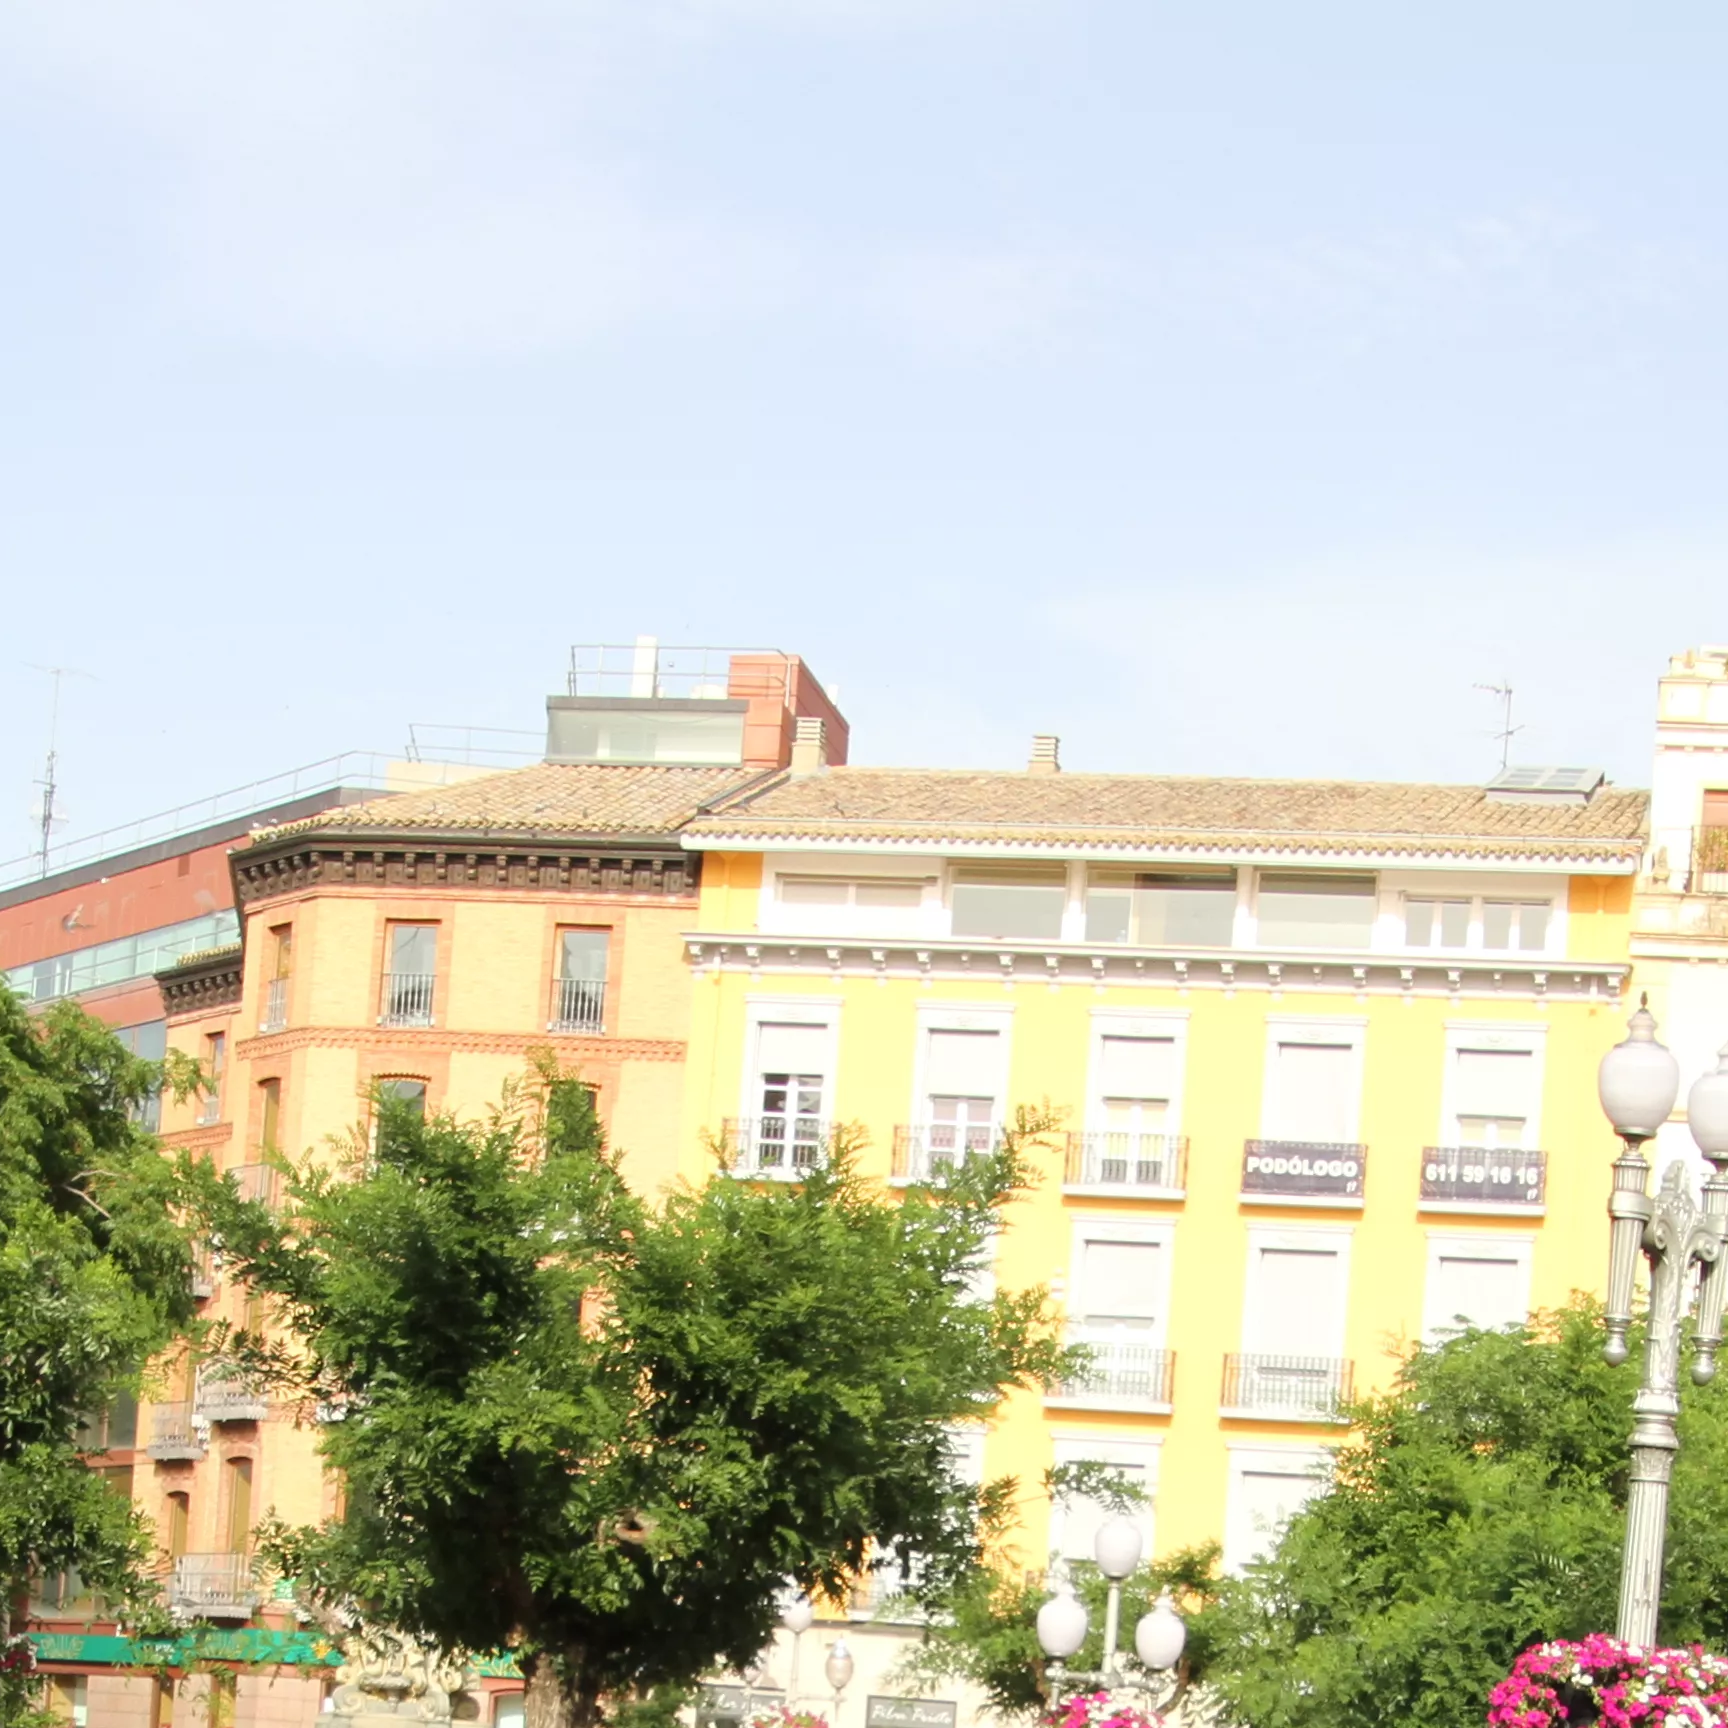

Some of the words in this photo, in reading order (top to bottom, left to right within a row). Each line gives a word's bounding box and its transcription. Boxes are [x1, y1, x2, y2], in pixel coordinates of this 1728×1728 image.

[1247, 1156, 1358, 1178] PODÓLOGO
[1425, 1163, 1457, 1183] 611
[1462, 1164, 1484, 1183] 59
[1490, 1166, 1511, 1184] 16
[1516, 1167, 1538, 1185] 16
